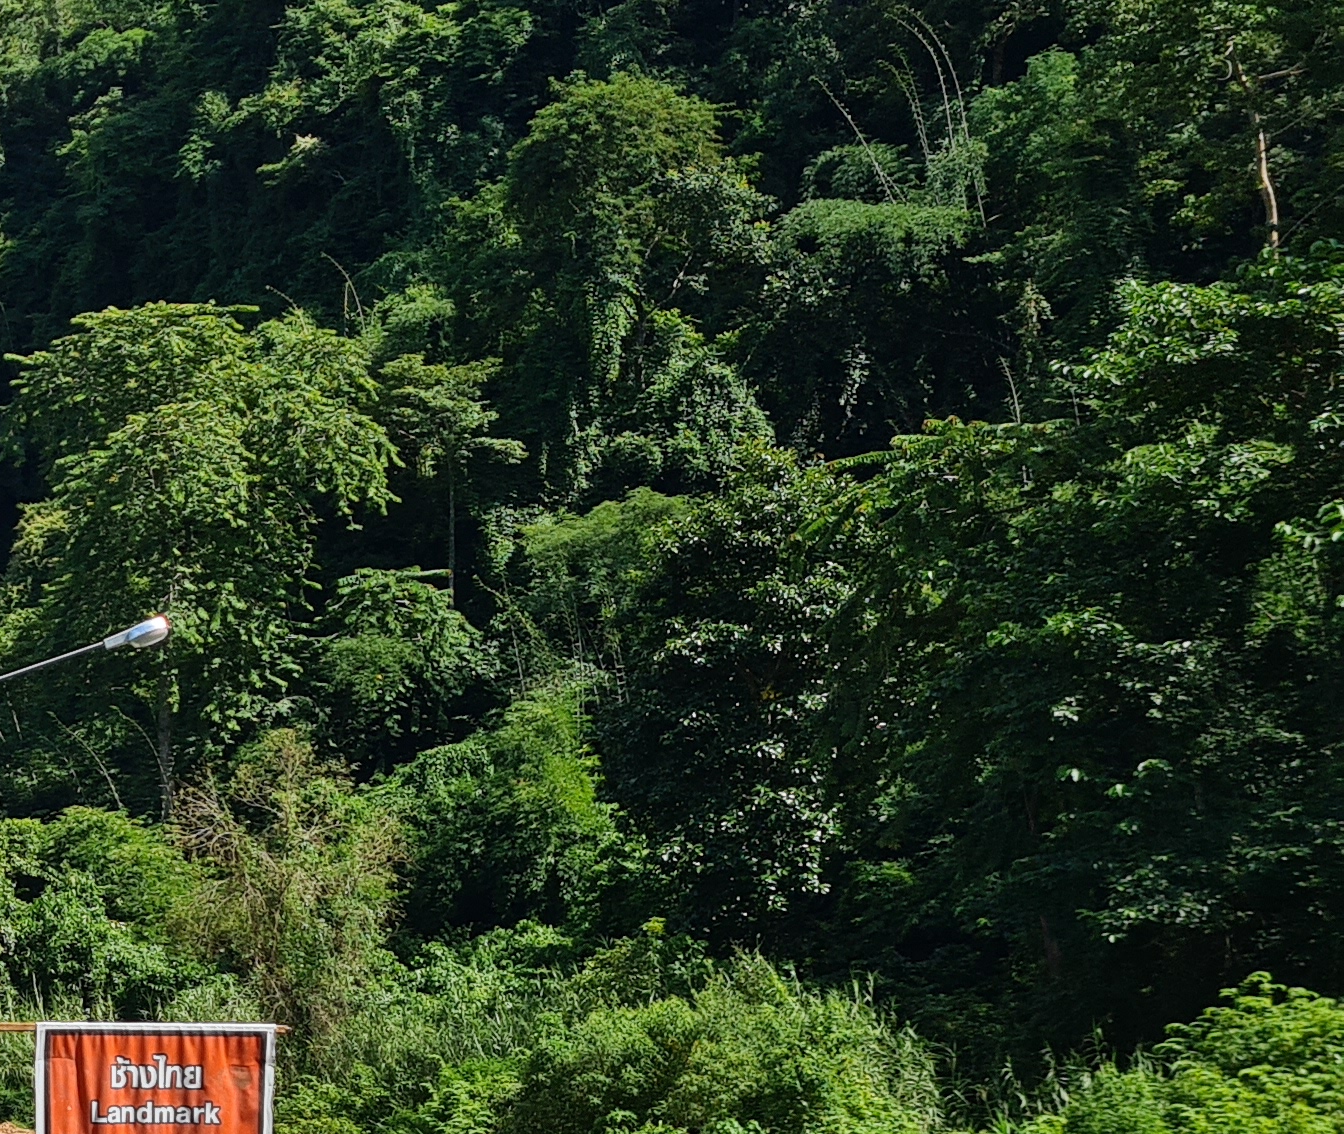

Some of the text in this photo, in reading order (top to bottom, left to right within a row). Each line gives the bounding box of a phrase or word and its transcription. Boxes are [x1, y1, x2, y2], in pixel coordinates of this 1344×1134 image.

[110, 1054, 203, 1090] ช้างไทย
[90, 1100, 221, 1126] Landmark
